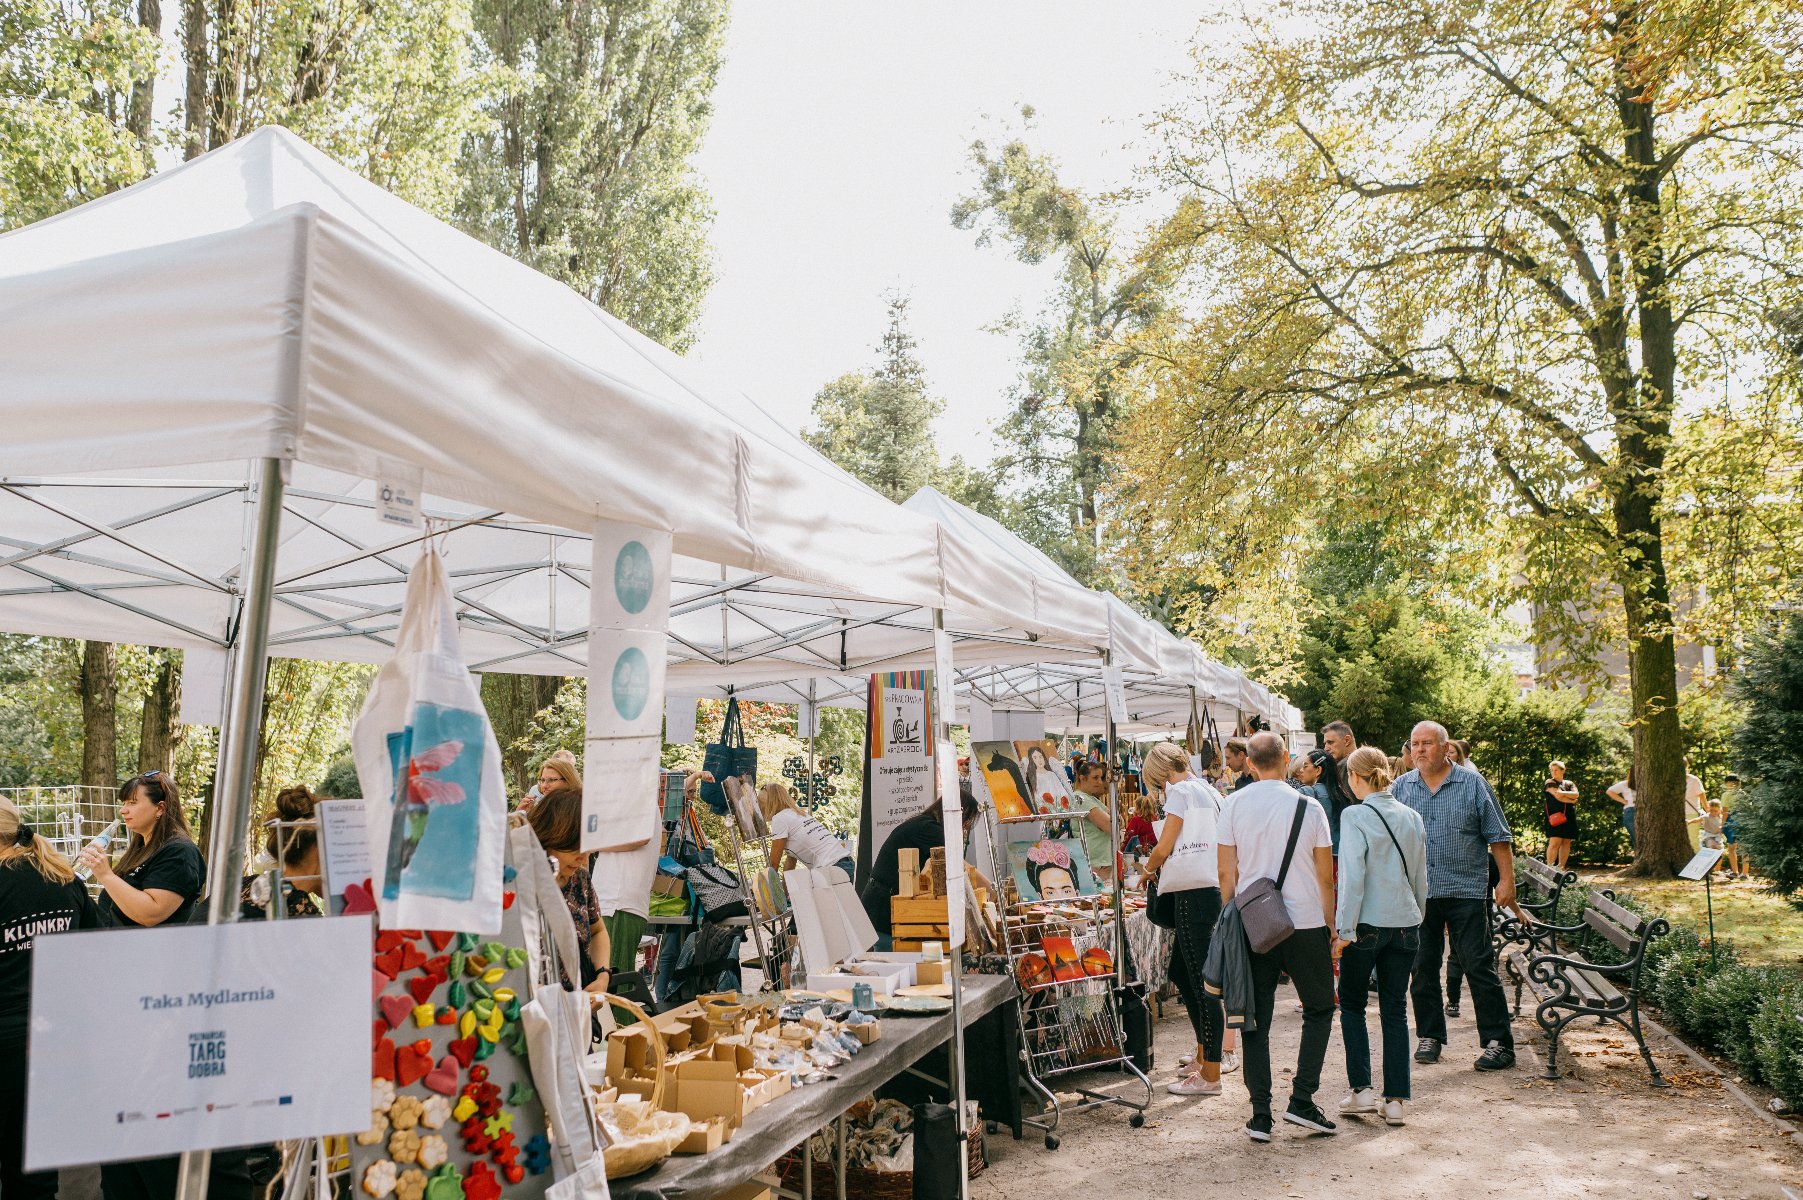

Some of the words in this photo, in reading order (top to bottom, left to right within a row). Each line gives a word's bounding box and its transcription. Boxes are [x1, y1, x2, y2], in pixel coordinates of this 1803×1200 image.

[4, 917, 71, 943] KLUNKRY
[17, 940, 34, 951] WIE
[140, 995, 182, 1009] Taka
[187, 987, 275, 1008] Mydlarnia
[189, 1041, 226, 1062] TARG
[188, 1062, 226, 1079] DOBRA
